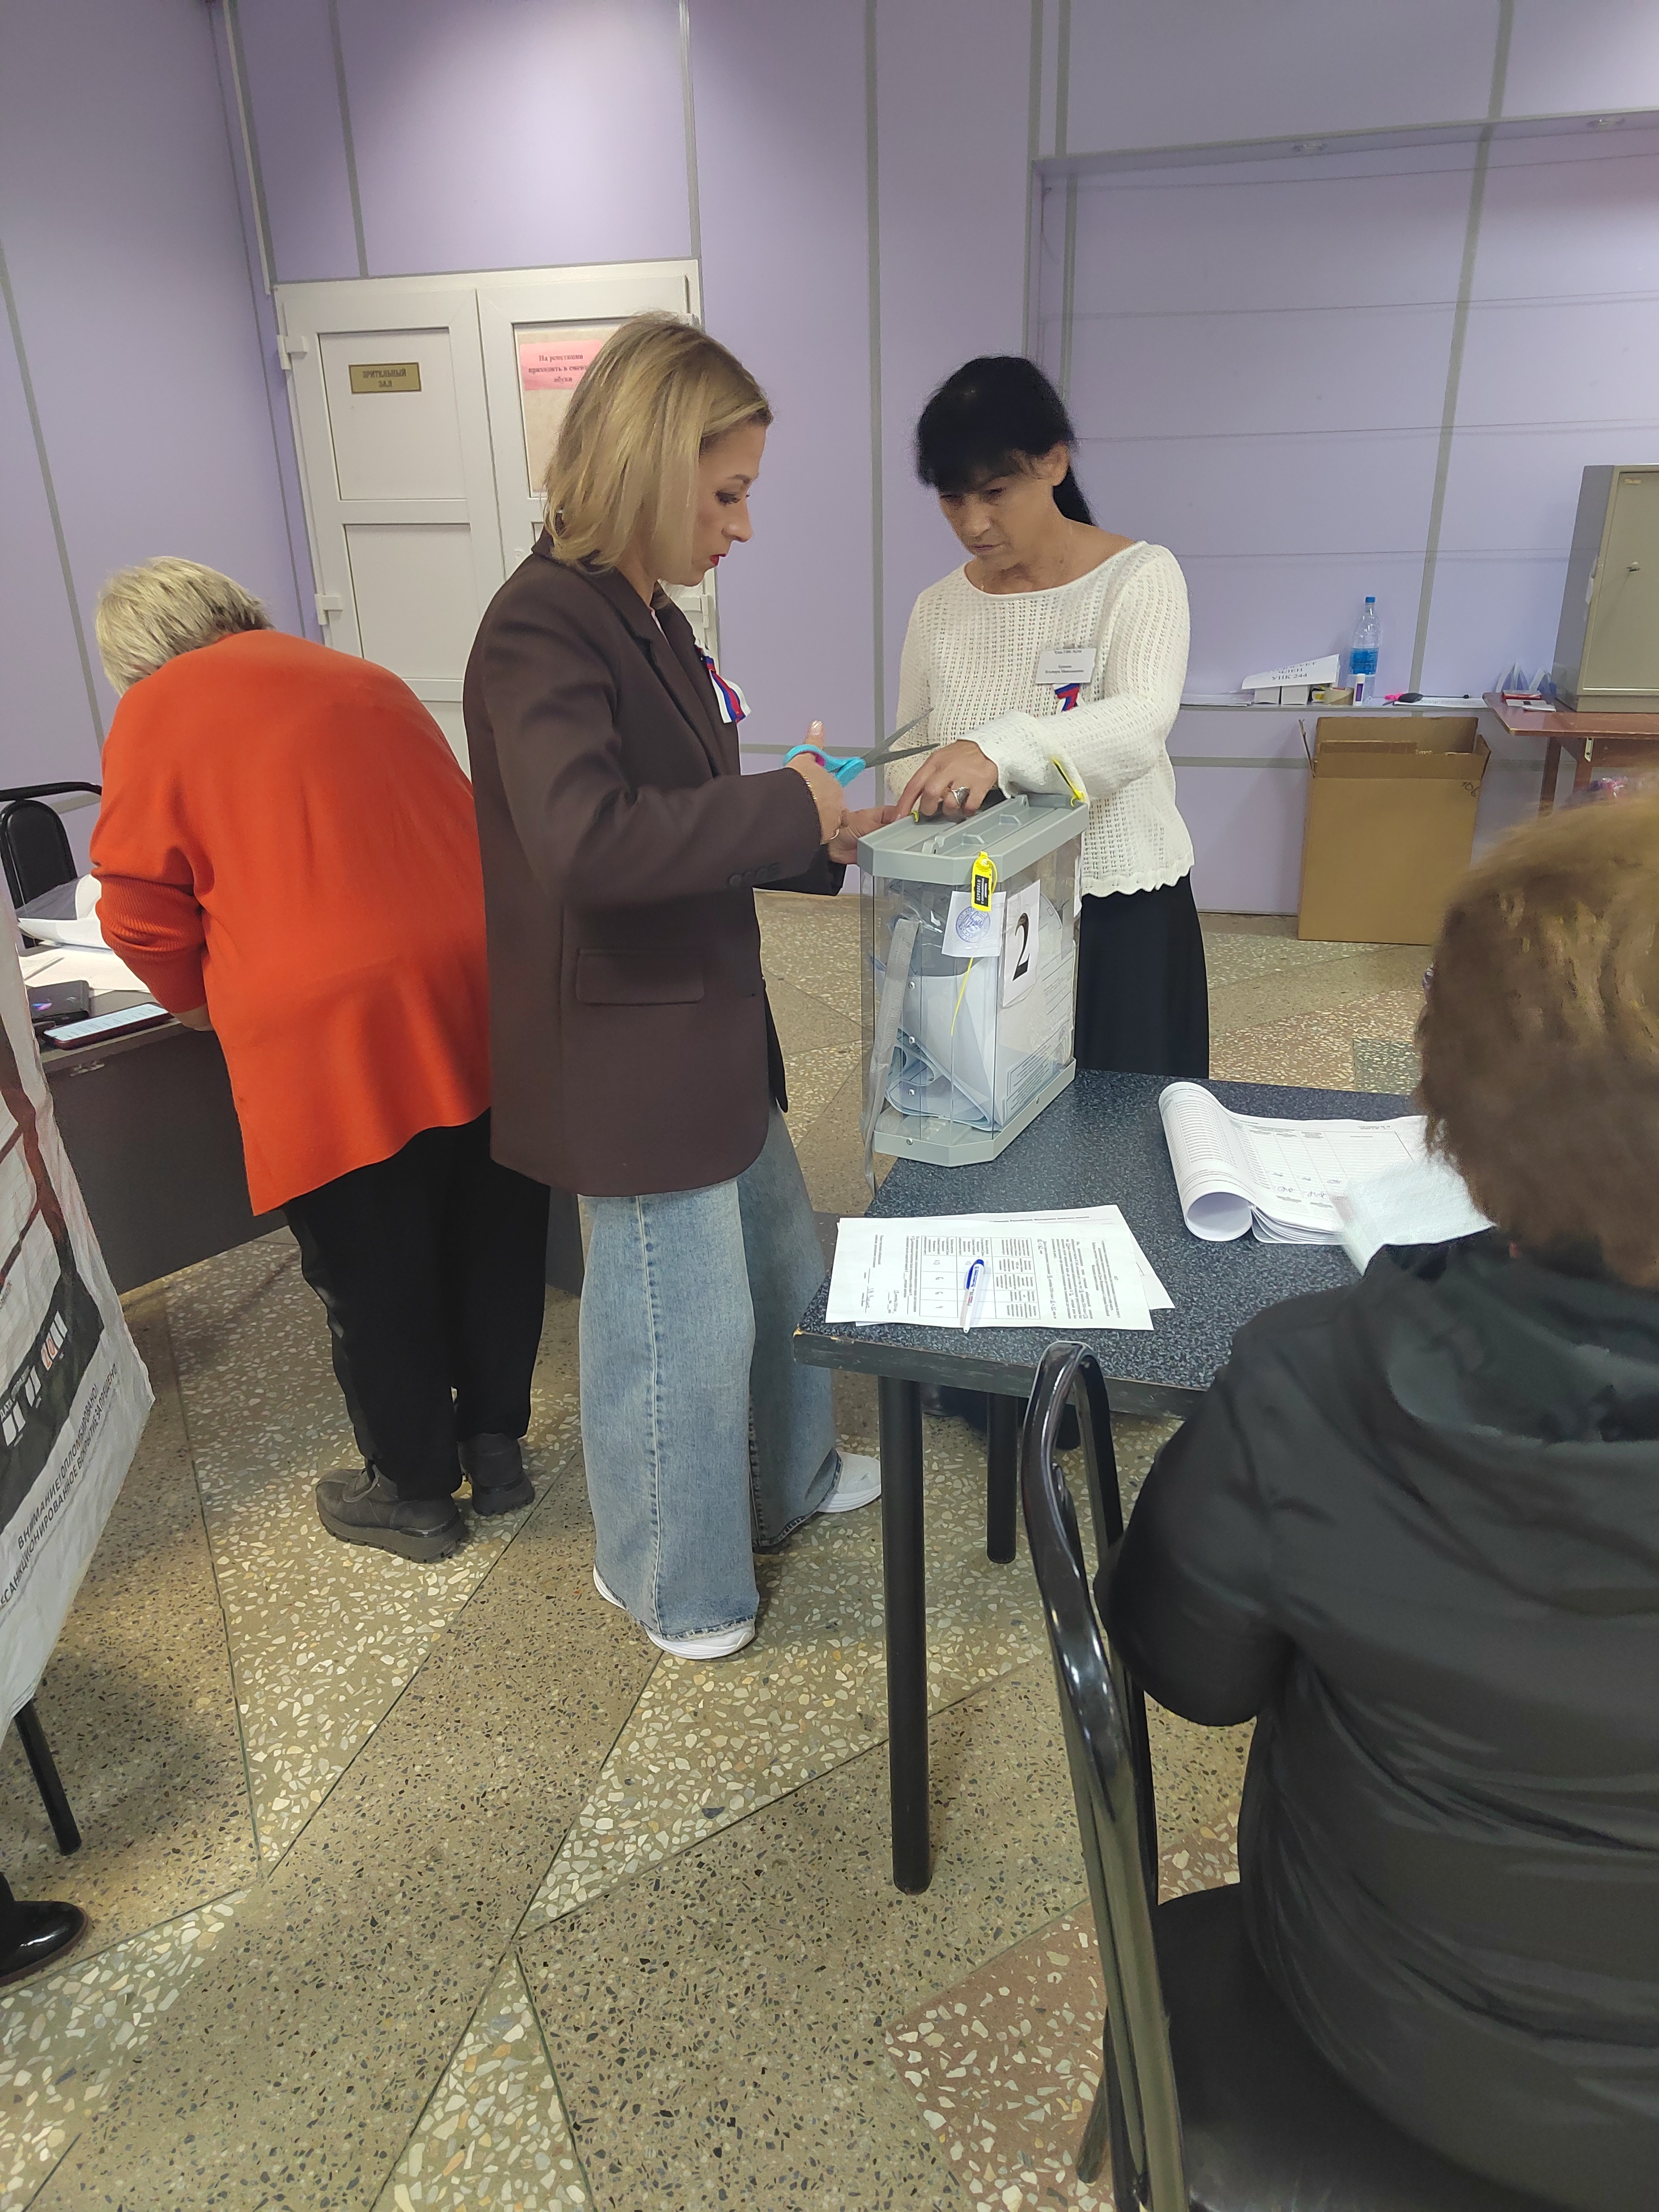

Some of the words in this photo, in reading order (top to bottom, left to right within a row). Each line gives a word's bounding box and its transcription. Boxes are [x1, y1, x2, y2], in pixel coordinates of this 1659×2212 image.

[362, 368, 407, 378] ЗРИТЕЛЬНЫЙ
[1012, 912, 1030, 982] 2
[0, 1465, 78, 1606] ЕСАНКЦИОНИРОВАННОЕ
